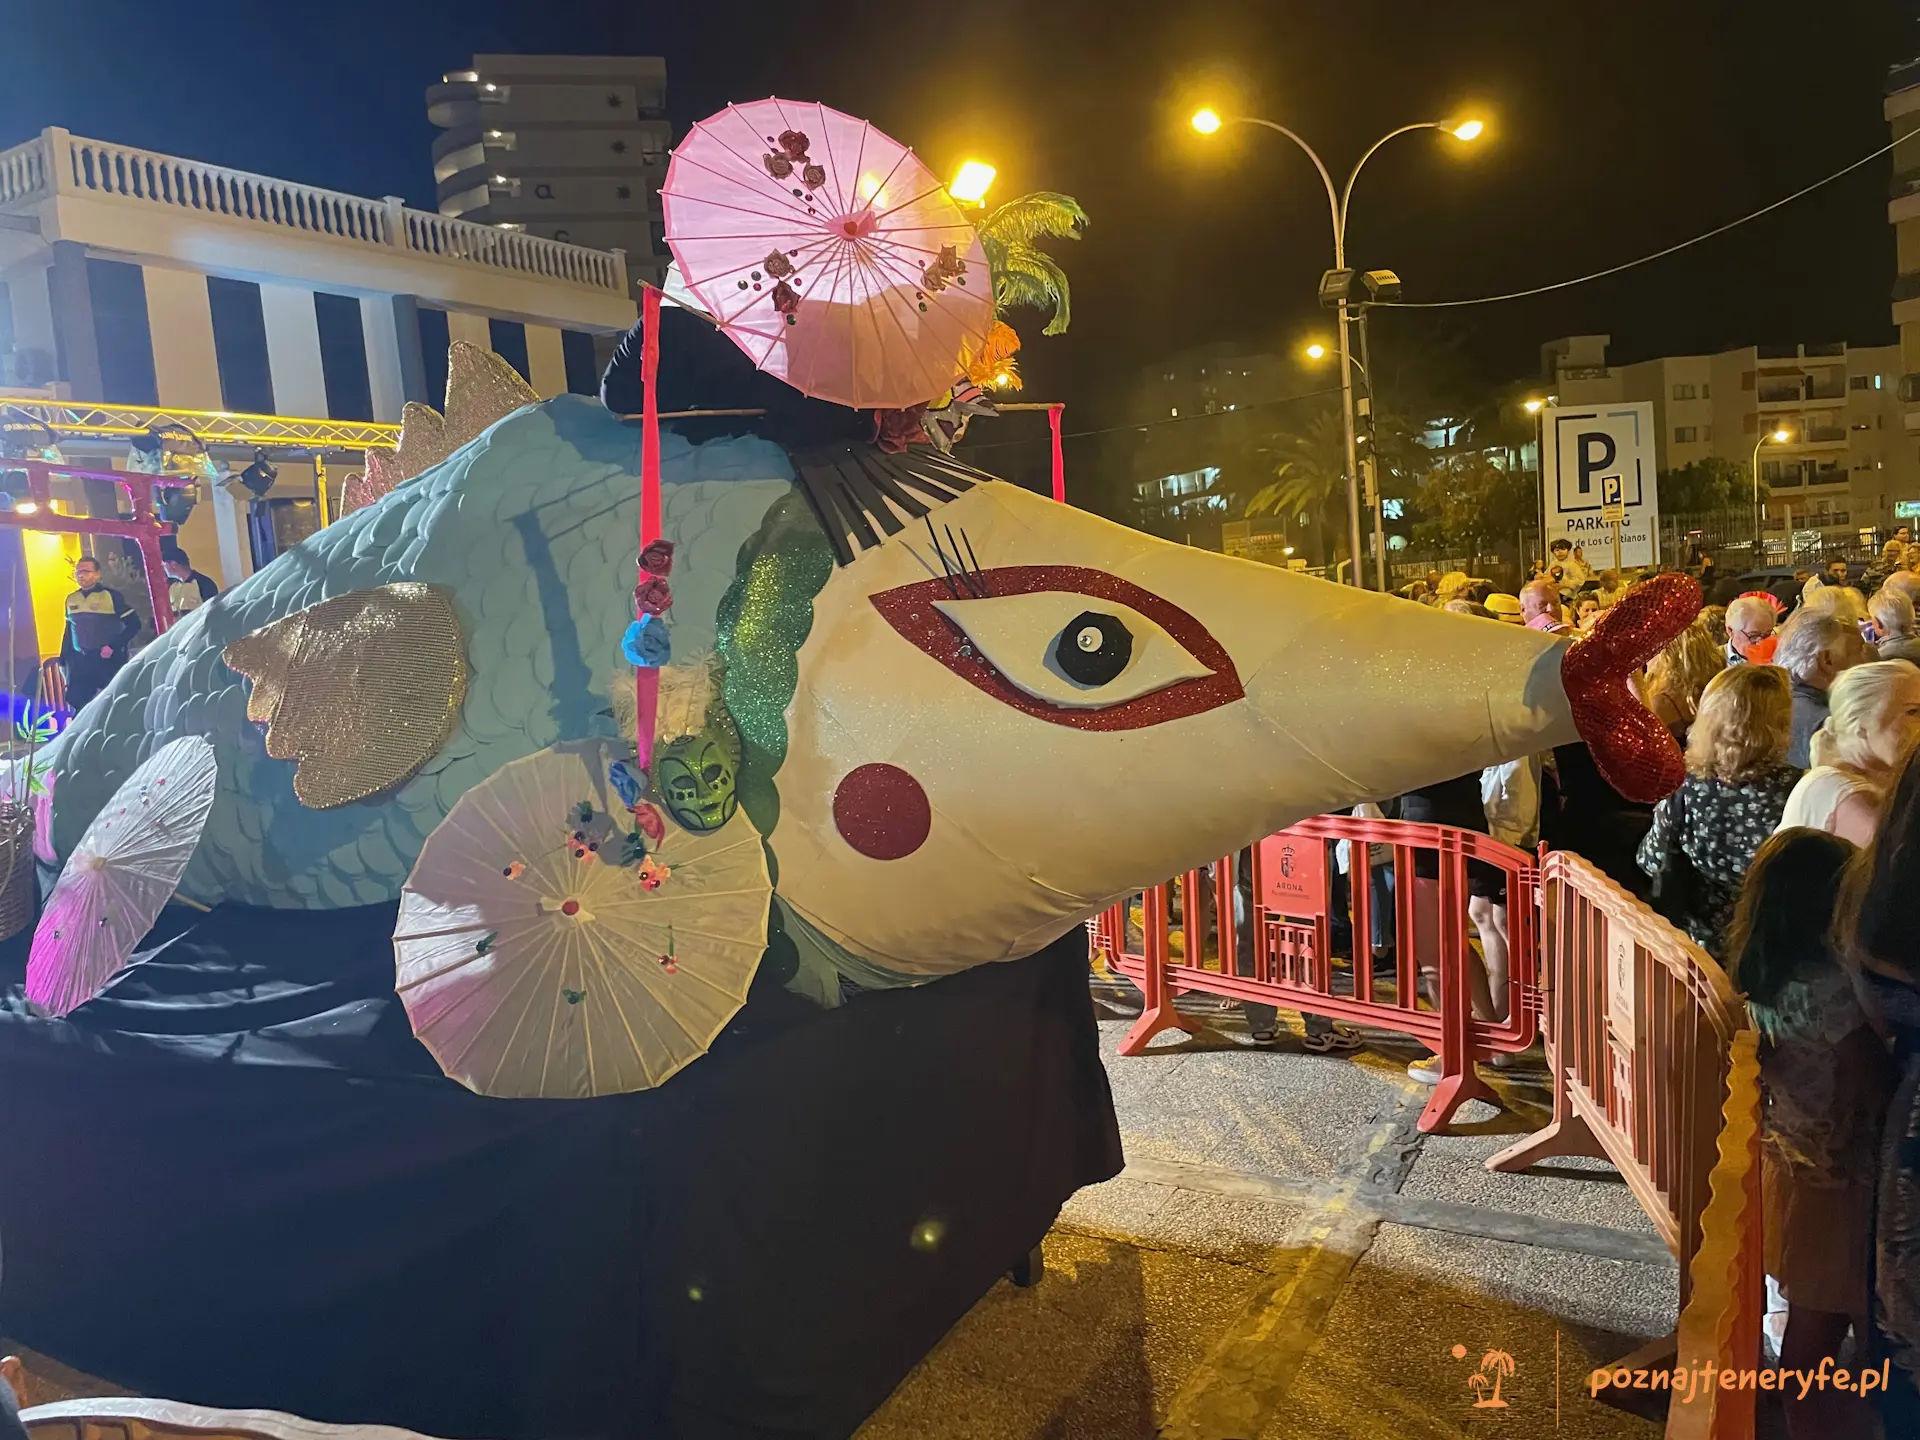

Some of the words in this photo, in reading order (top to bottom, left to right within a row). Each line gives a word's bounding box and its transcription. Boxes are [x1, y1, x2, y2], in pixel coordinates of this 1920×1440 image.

[1577, 432, 1616, 494] P
[1604, 478, 1618, 504] P
[1575, 538, 1586, 547] de
[1588, 538, 1602, 546] Los
[1604, 534, 1646, 545] Crtianos
[1276, 882, 1303, 892] ARONA
